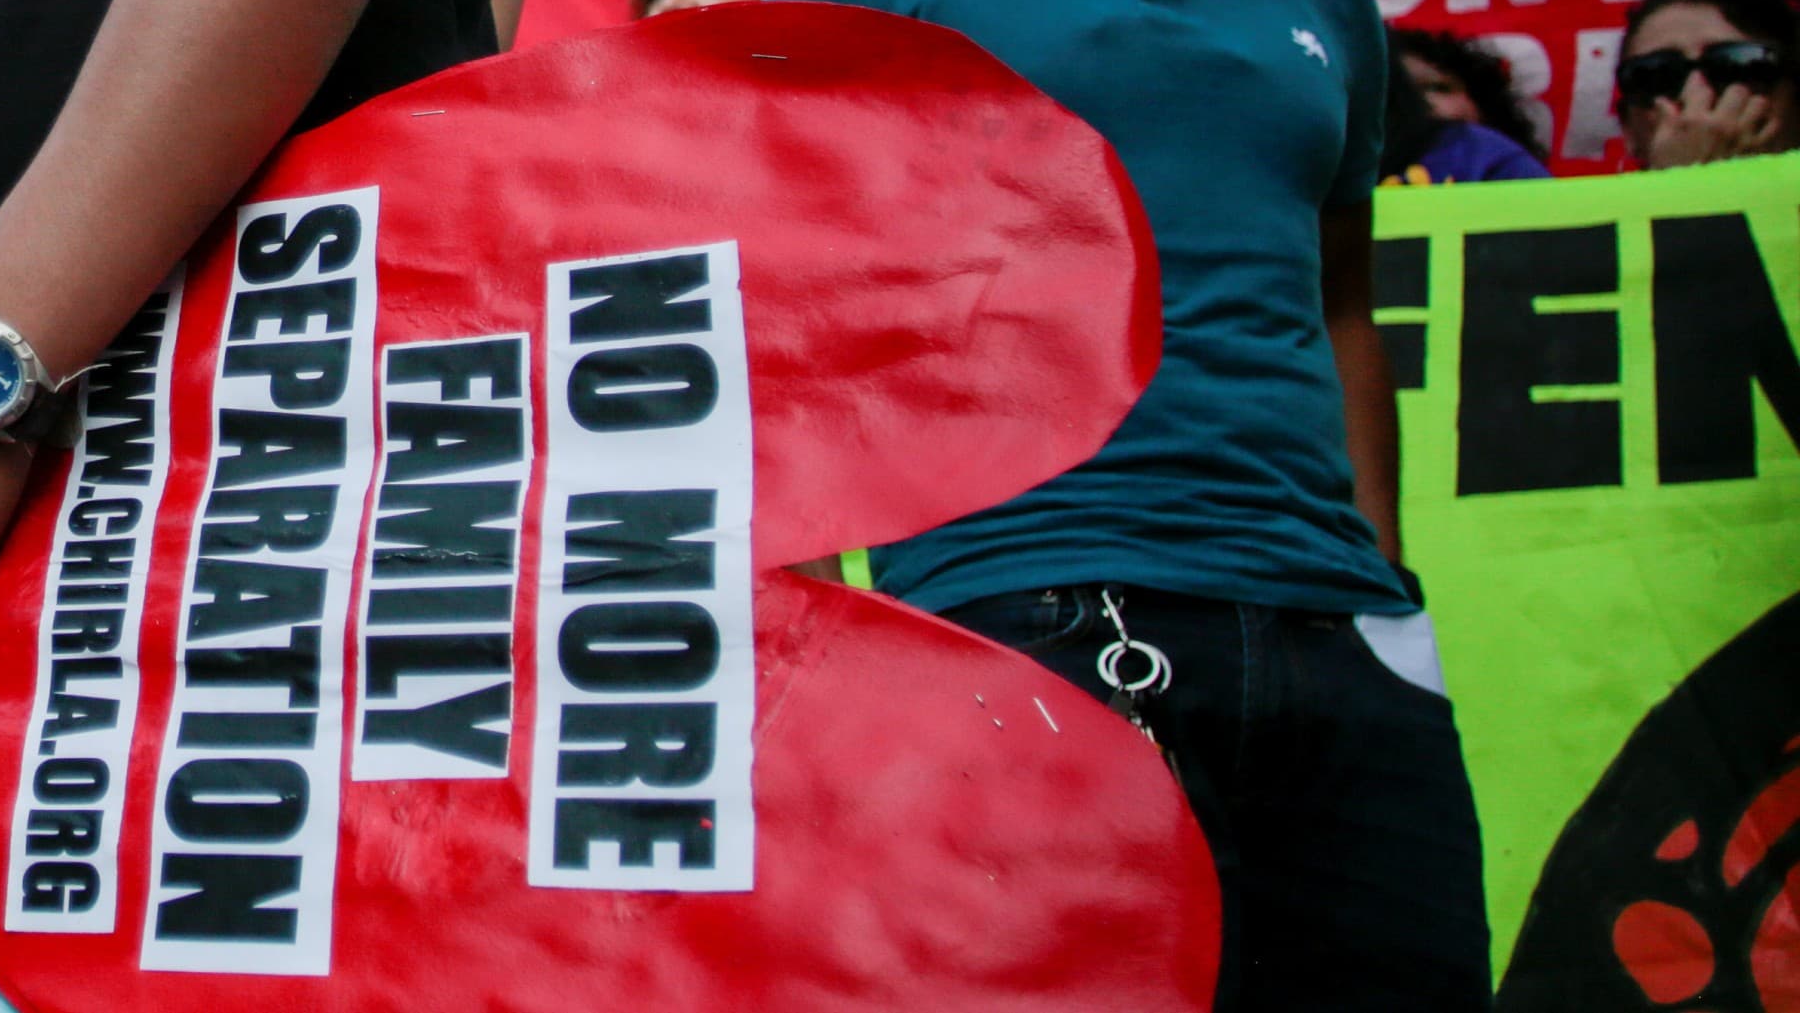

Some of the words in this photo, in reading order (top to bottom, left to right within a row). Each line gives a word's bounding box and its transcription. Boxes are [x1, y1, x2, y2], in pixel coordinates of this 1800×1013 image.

[567, 254, 719, 432] NO
[155, 201, 361, 945] SEPARATION
[360, 336, 526, 768] FAMILY
[553, 488, 720, 870] MORE
